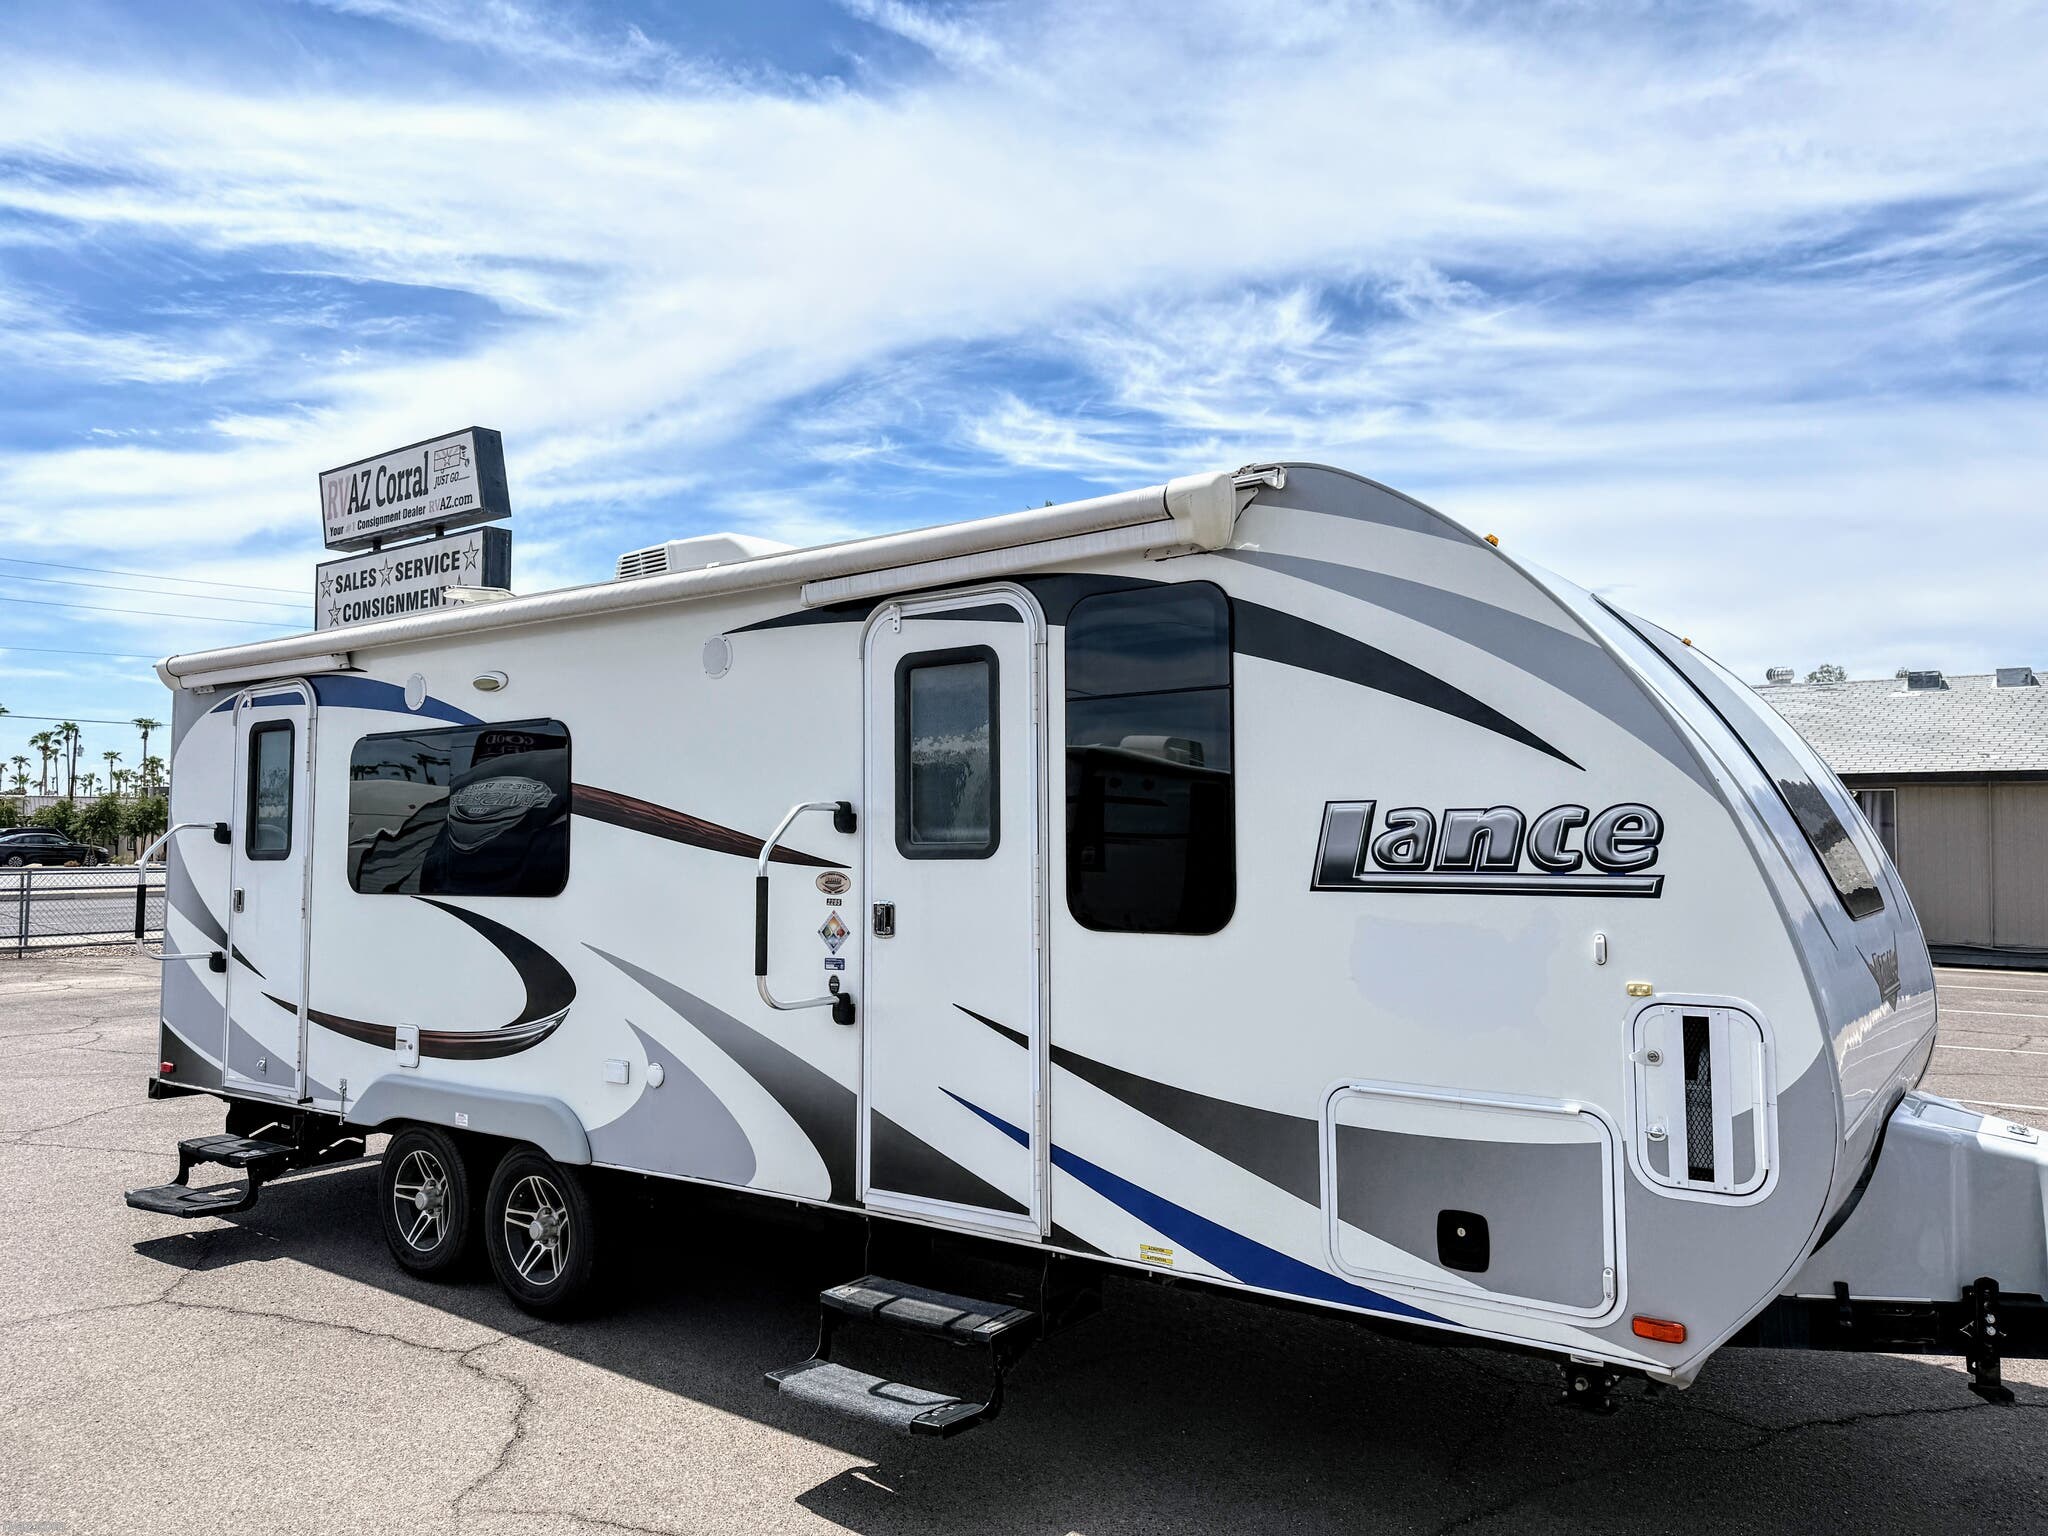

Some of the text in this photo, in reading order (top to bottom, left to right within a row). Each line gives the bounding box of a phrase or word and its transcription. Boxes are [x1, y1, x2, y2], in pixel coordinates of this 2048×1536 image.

[375, 451, 429, 507] Corral
[434, 474, 449, 489] JUST
[330, 525, 344, 537] Your
[357, 513, 401, 531] Consignment
[402, 505, 426, 519] Dealer
[335, 550, 461, 594] SALES SERVICE
[343, 586, 449, 622] CONSIGNMENT
[1310, 799, 1665, 899] Lance
